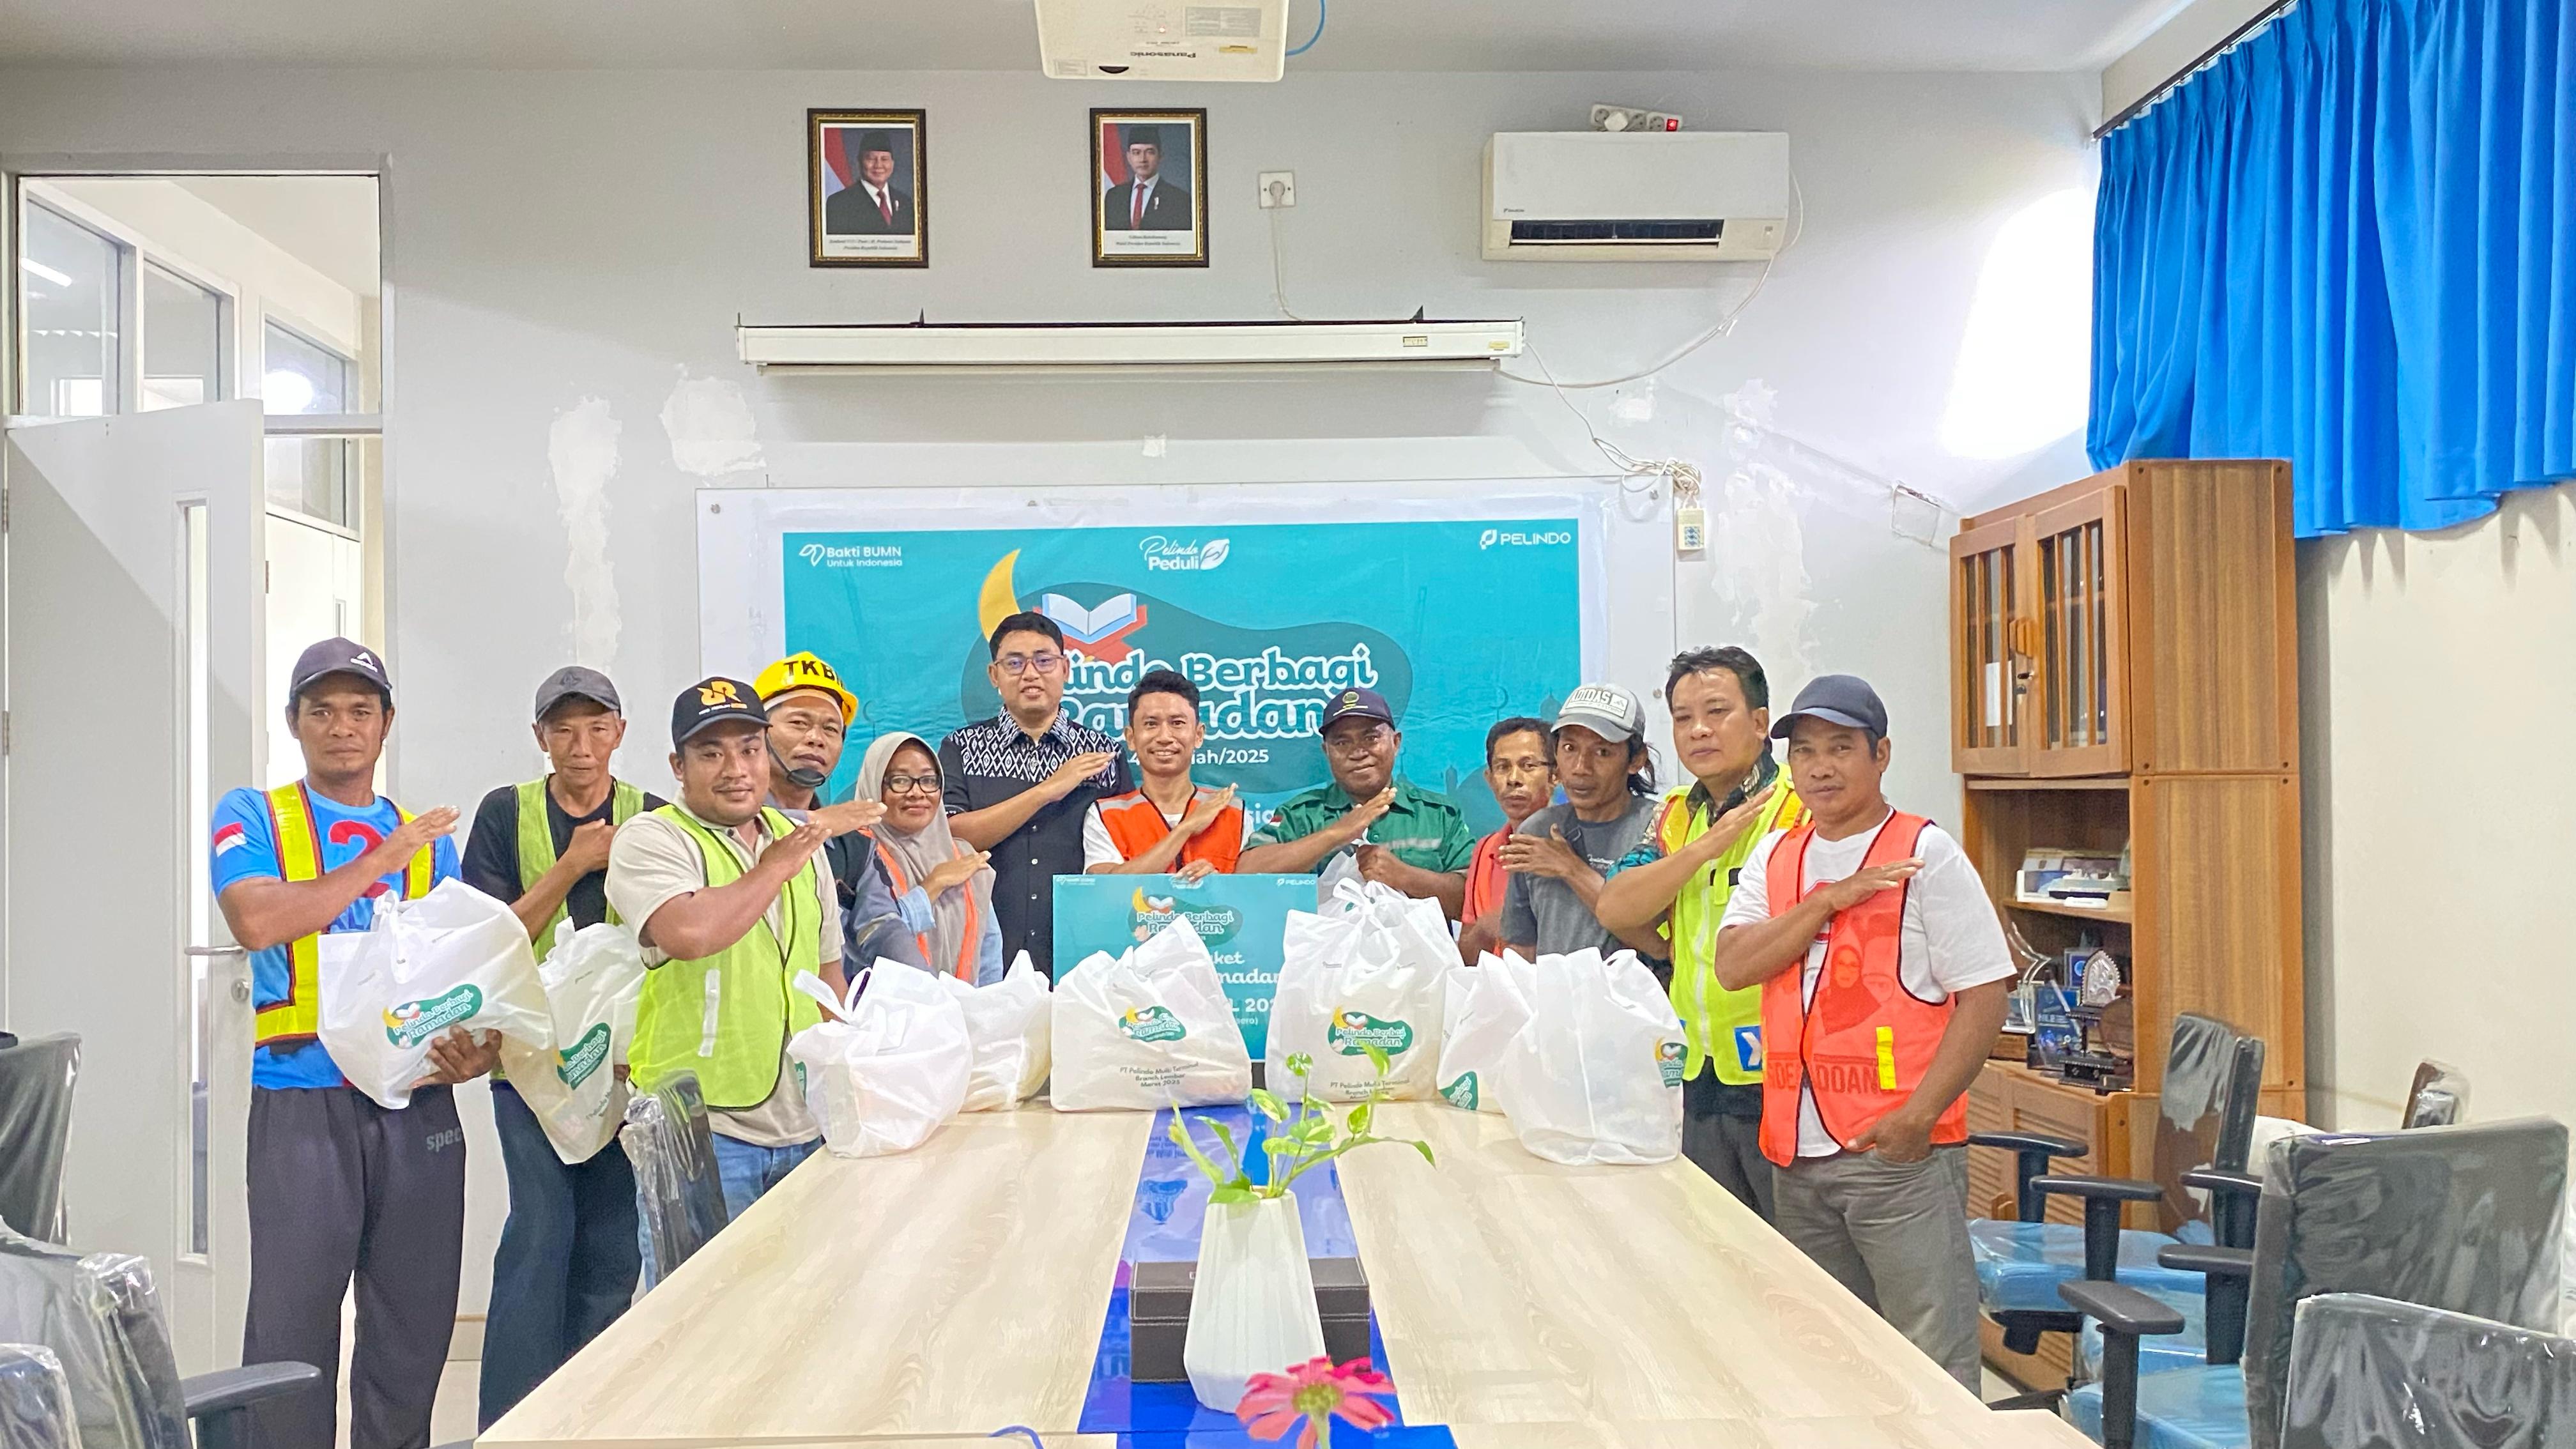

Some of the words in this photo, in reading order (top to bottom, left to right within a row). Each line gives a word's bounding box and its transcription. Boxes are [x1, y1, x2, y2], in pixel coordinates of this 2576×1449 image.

[1500, 532, 1572, 545] PELINDO
[827, 546, 860, 558] Bakti
[863, 546, 902, 557] BUMN
[1139, 535, 1199, 561] Pelindo
[1148, 556, 1199, 571] Peduli
[1180, 642, 1379, 699] Berbagi
[1571, 688, 1611, 705] ADIDAS
[1191, 747, 1269, 765] iah/2025
[1210, 950, 1245, 965] ket
[406, 1002, 472, 1039] Ramadan
